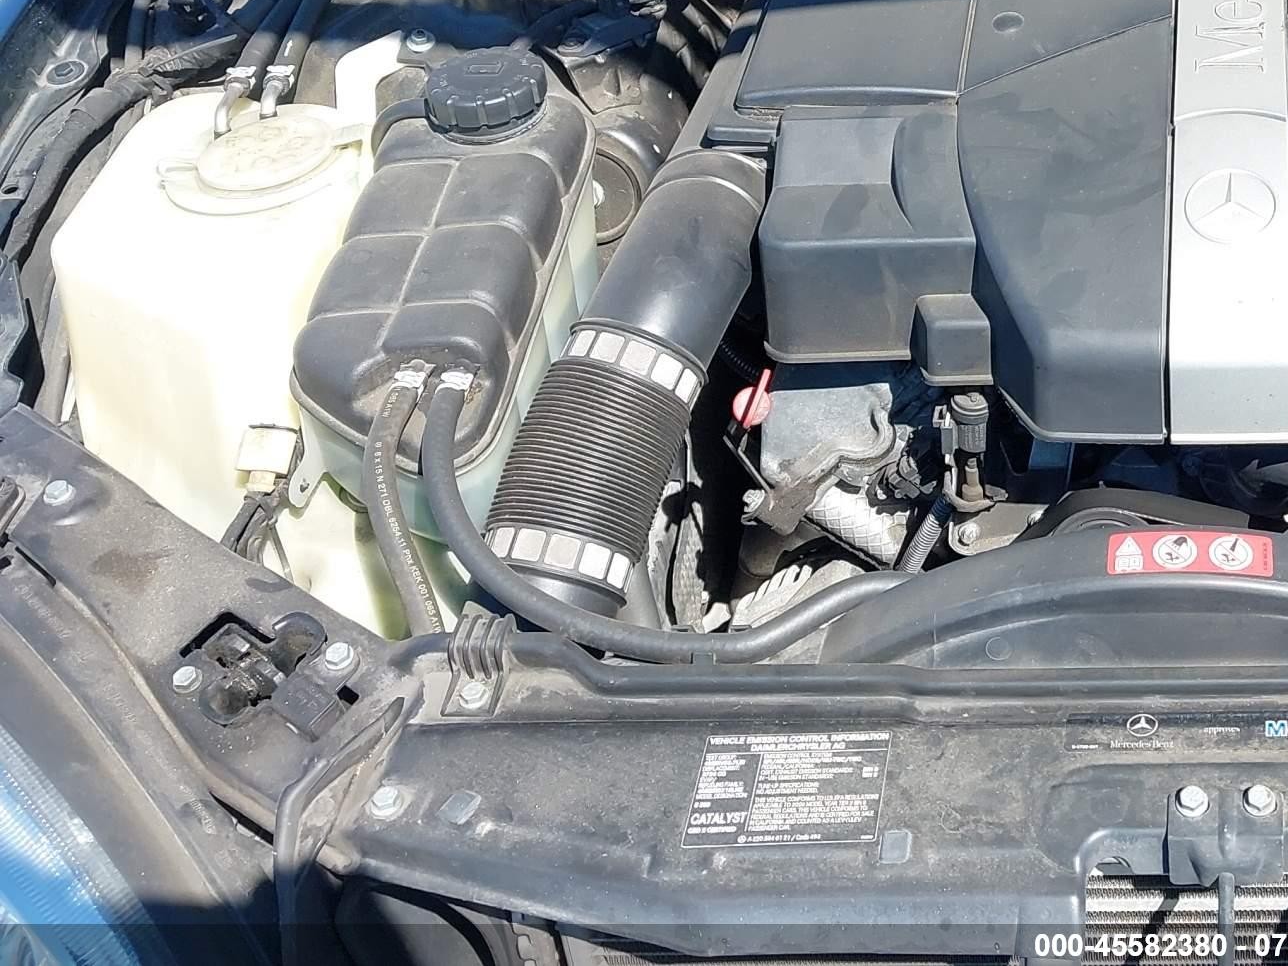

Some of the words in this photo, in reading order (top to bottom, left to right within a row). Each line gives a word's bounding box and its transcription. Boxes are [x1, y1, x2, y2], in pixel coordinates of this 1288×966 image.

[710, 736, 745, 745] VEHICLE
[746, 735, 787, 744] EMISSION
[789, 734, 830, 743] CONTROL
[831, 732, 889, 742] INFORMATION
[751, 742, 831, 752] DAIMLERCHRYSLER
[832, 741, 846, 750] AG
[690, 811, 748, 825] CATALYST
